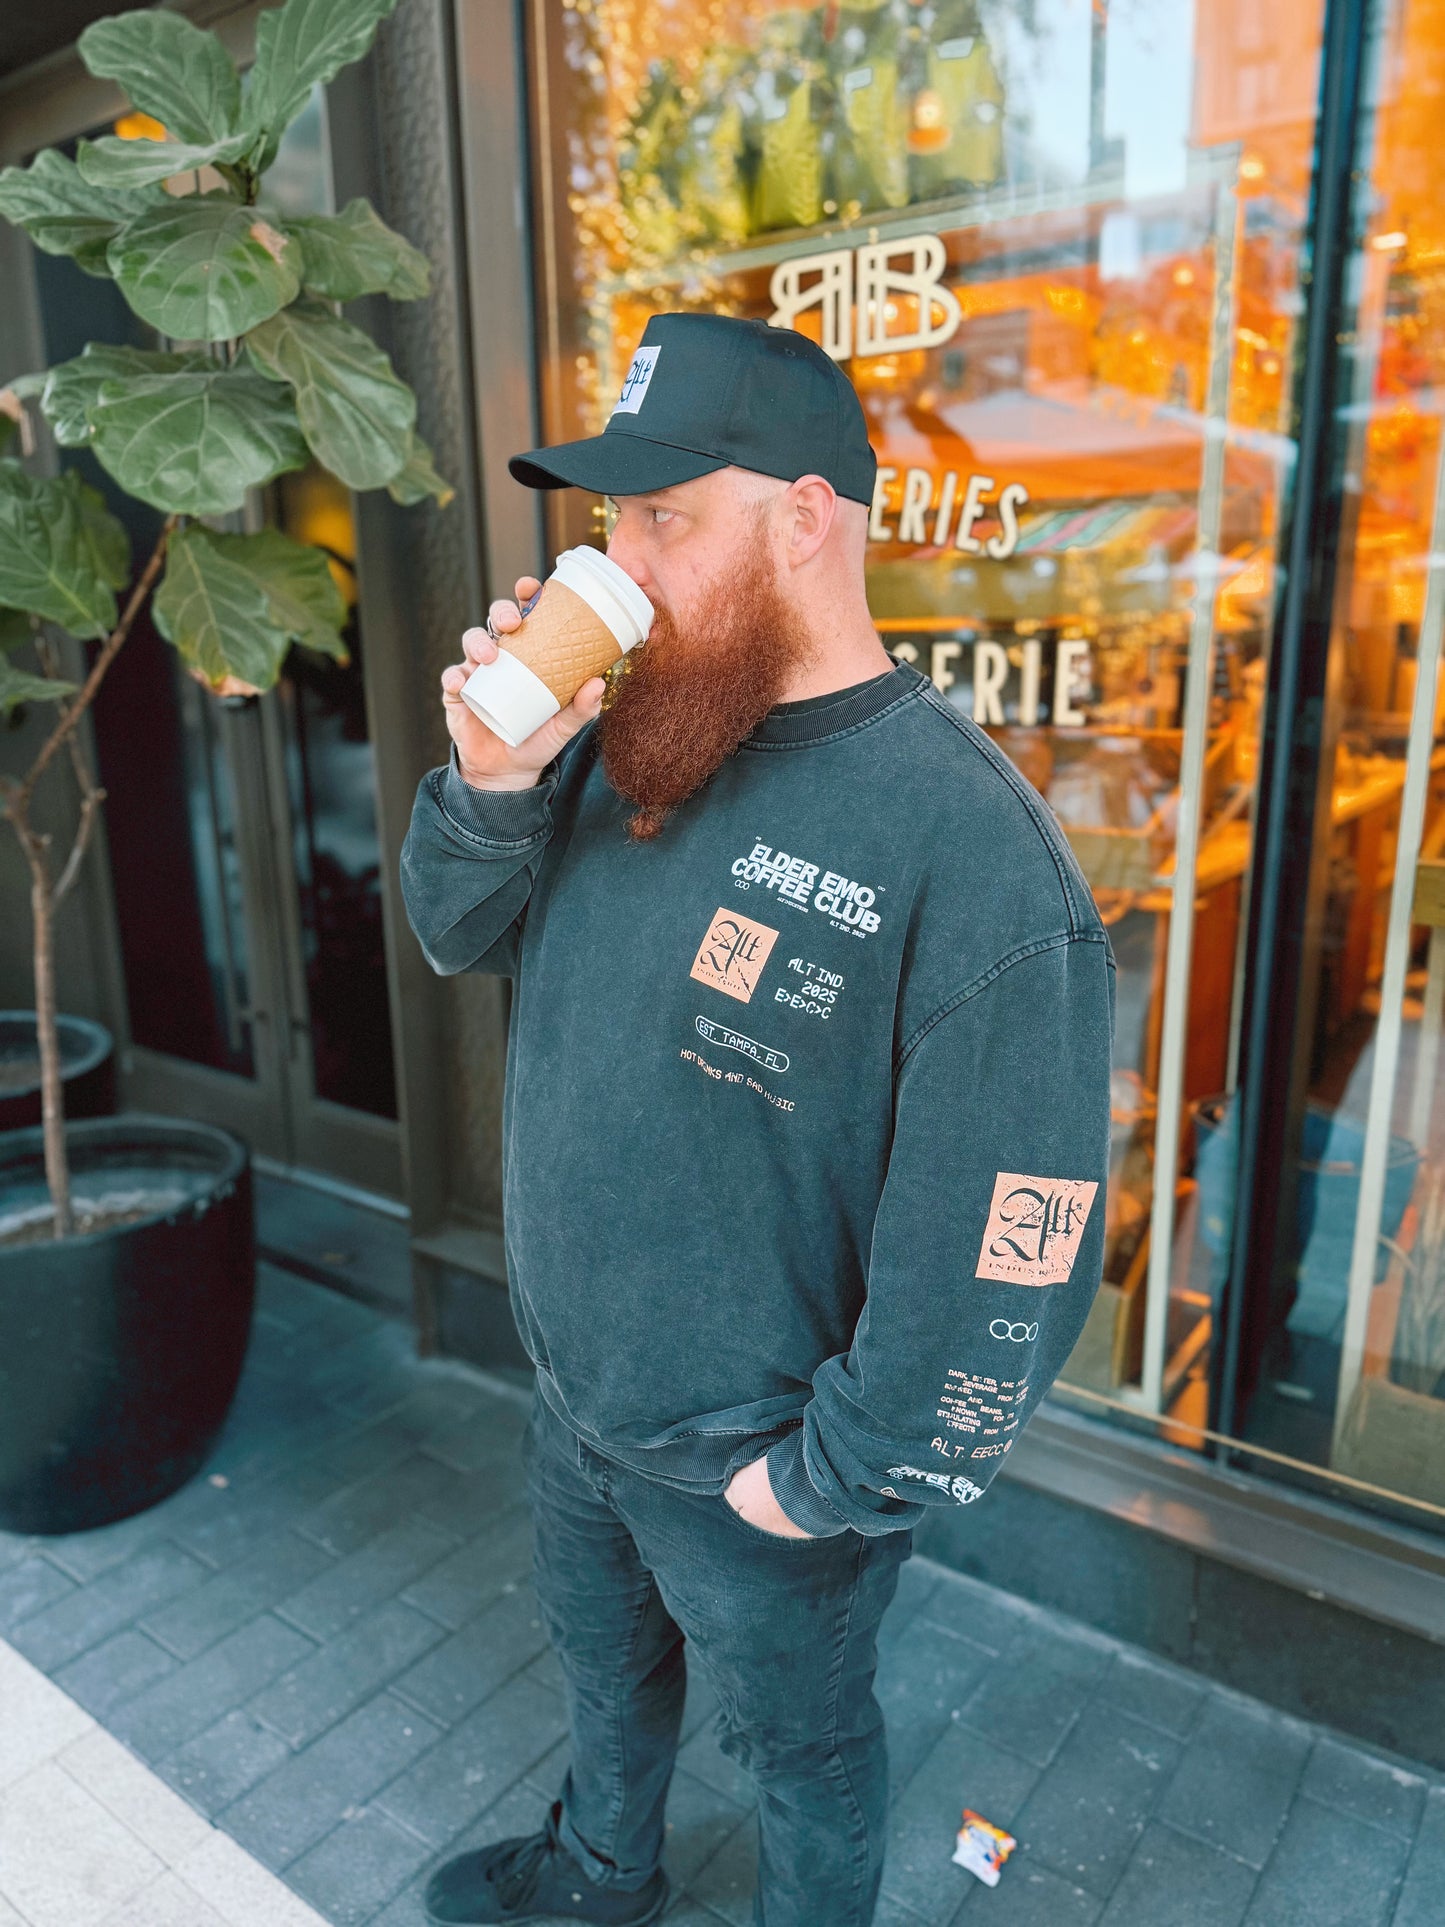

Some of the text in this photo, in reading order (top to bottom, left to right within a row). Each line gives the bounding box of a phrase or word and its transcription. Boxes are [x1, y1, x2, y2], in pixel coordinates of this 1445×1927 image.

[731, 857, 882, 933] COFFEE CLUB
[748, 843, 876, 908] ELDER EMO
[787, 957, 845, 990] ALT IND.
[801, 981, 838, 1003] 2025
[699, 1020, 780, 1069] EST. TAMPA, FL
[680, 1048, 697, 1062] HOT
[724, 1071, 744, 1083] AND
[746, 1077, 763, 1093] SAD
